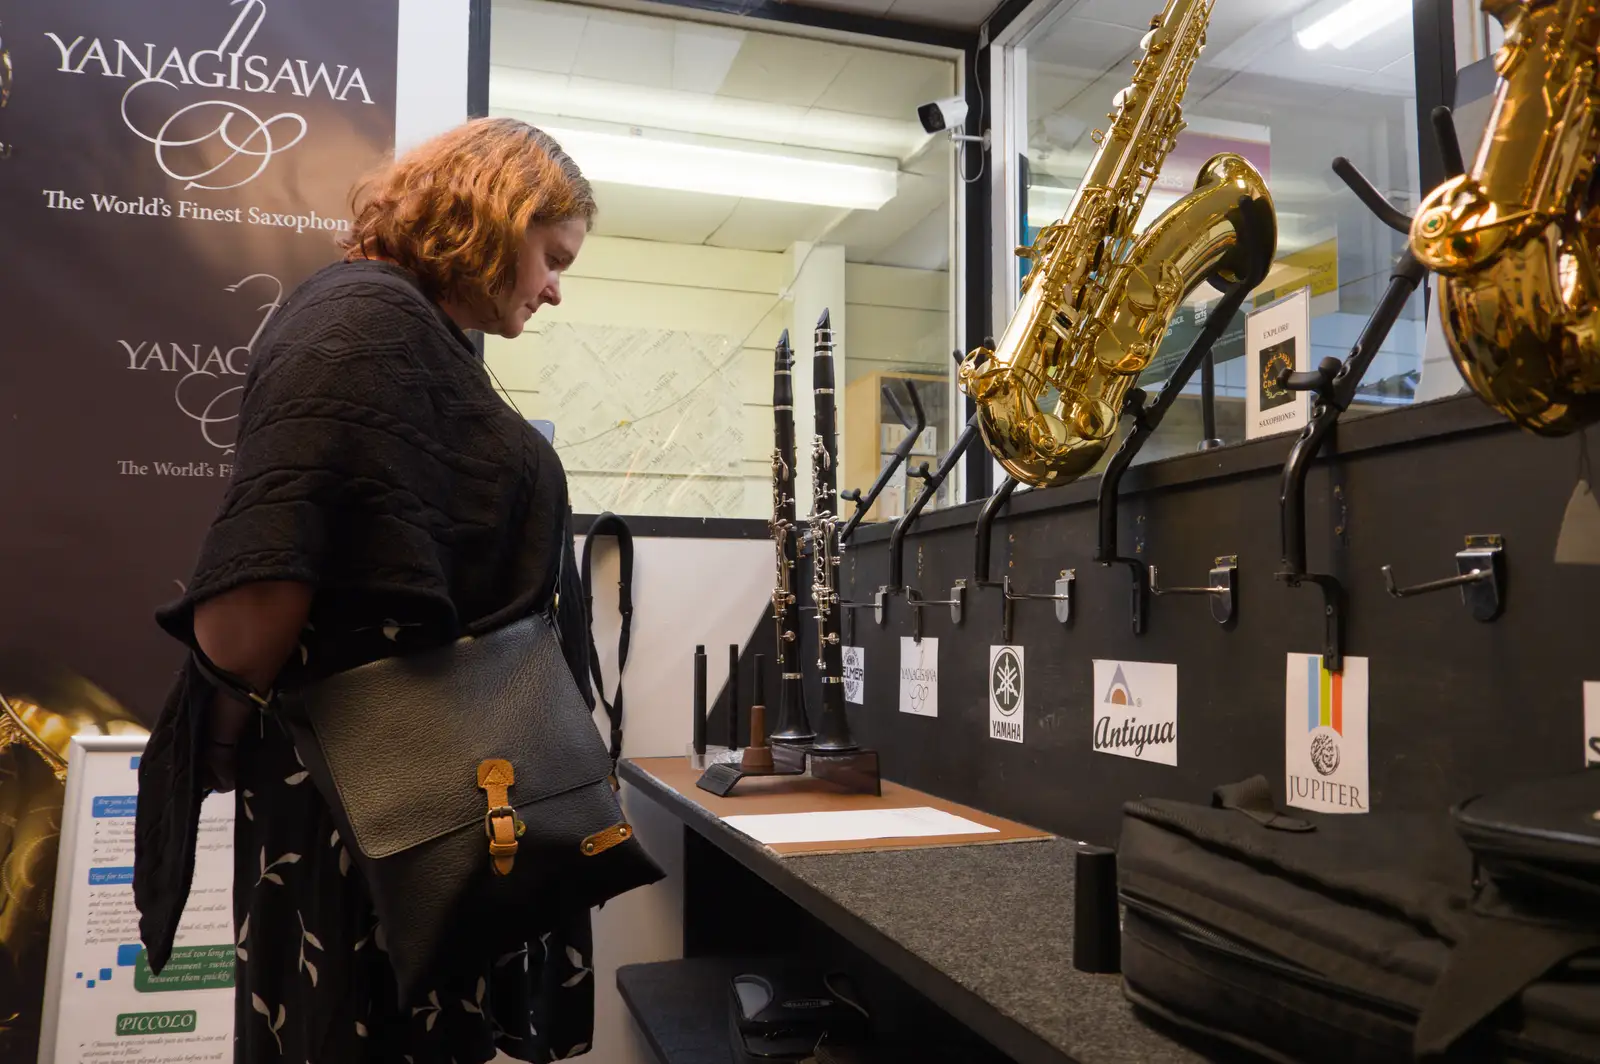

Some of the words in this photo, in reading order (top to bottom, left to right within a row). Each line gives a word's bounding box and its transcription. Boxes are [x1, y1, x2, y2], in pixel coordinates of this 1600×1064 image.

[43, 32, 375, 104] YANAGISAWA
[42, 189, 85, 211] The
[177, 201, 241, 223] Finest
[247, 207, 349, 233] Saxophon
[1263, 323, 1289, 339] EXPLORE
[116, 339, 250, 375] YANAG
[1262, 377, 1277, 389] Cha
[1259, 410, 1296, 428] SAXOPHONES
[117, 460, 148, 476] The
[843, 666, 863, 681] ELMER
[992, 720, 1021, 741] YAMAHA
[1094, 716, 1176, 757] Antigua
[1288, 775, 1367, 810] JUPITER
[194, 951, 206, 959] too
[207, 948, 225, 959] long
[181, 973, 200, 982] them
[202, 971, 231, 984] quickly
[119, 1014, 193, 1031] PICCOLO
